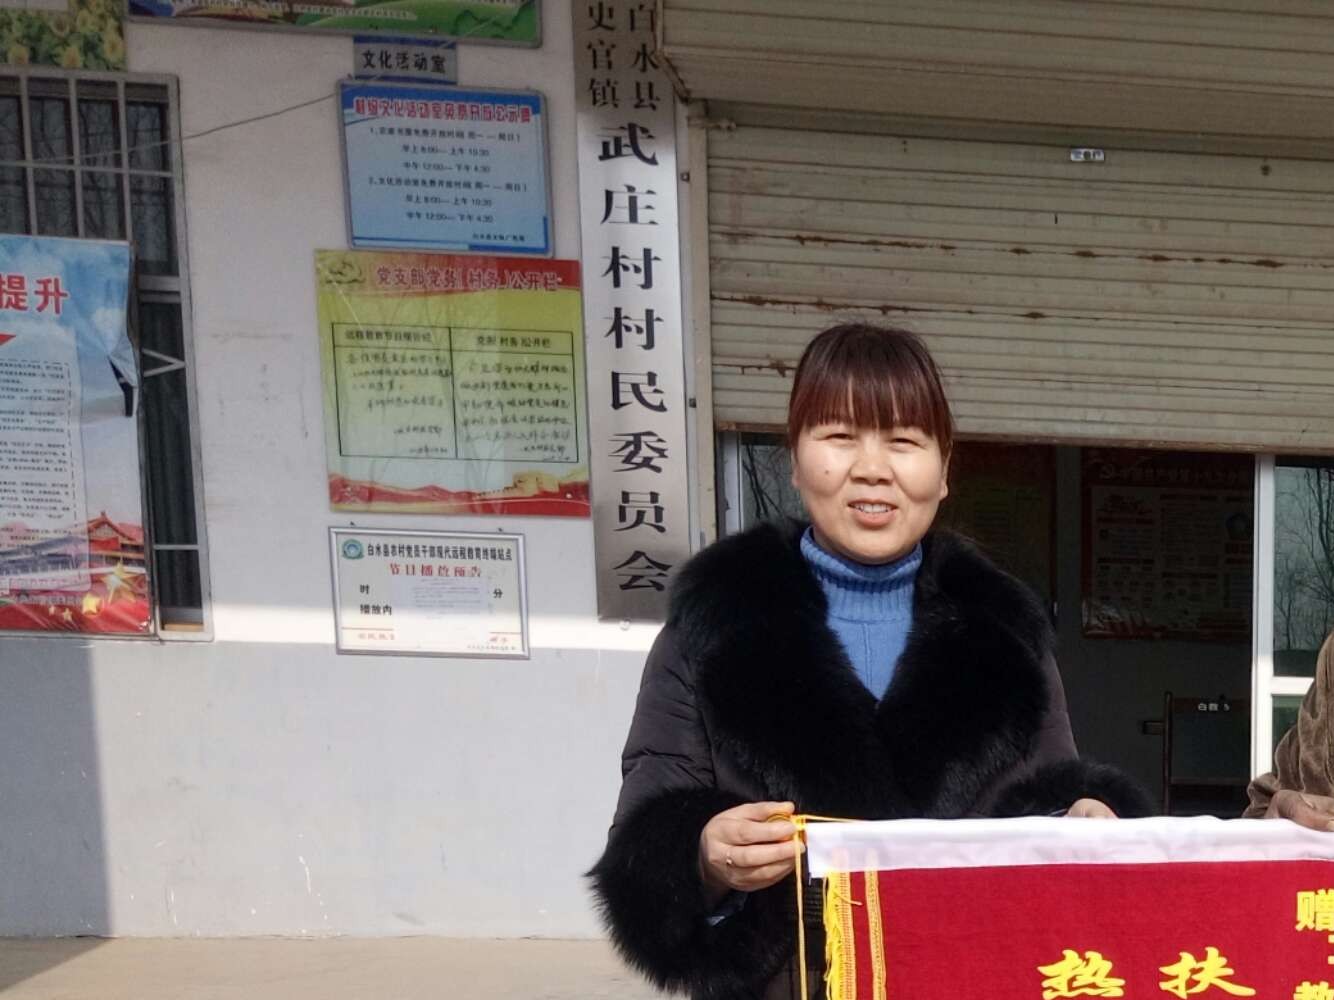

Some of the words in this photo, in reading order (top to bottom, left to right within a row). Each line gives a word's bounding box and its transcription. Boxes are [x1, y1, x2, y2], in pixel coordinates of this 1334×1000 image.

[362, 49, 446, 74] 文化活动室
[586, 1, 619, 109] 史官镇
[629, 4, 661, 111] 白水县
[0, 272, 68, 315] 提升
[598, 122, 673, 592] 武庄村村民委员会
